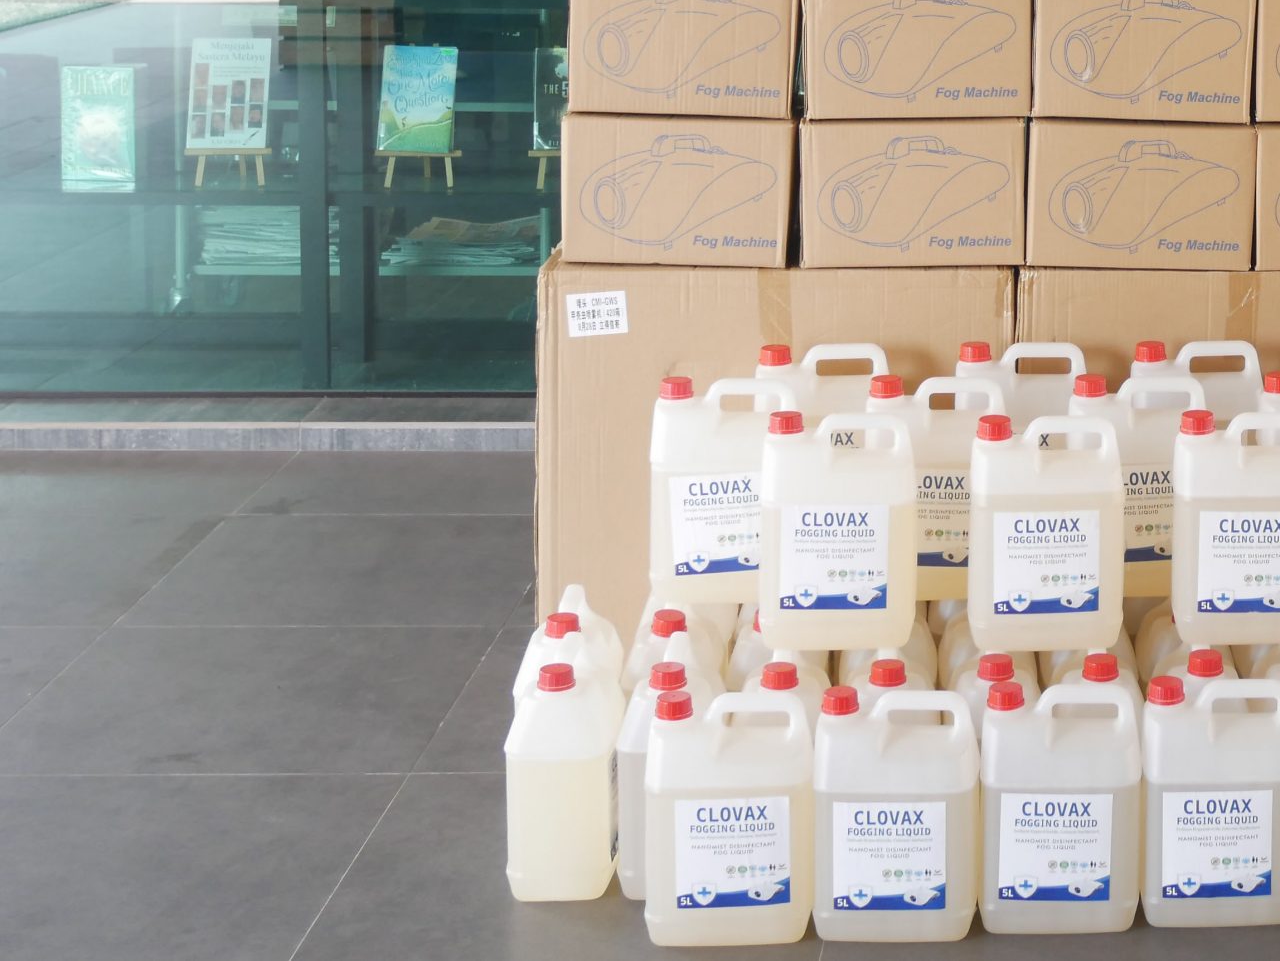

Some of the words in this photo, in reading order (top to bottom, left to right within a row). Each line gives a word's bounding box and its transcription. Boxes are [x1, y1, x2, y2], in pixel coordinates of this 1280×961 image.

[544, 84, 560, 94] THE
[695, 84, 720, 99] Fog
[724, 85, 781, 99] Machine
[935, 87, 962, 101] Fog
[964, 87, 1018, 99] Machine
[1158, 91, 1183, 105] Fog
[1187, 91, 1241, 105] Machine
[693, 235, 718, 250] Fog
[723, 235, 778, 249] Machine
[928, 235, 955, 250] Fog
[958, 235, 1012, 248] Machine
[1158, 239, 1182, 253] Fog
[1186, 239, 1240, 252] Machine
[689, 479, 751, 497] CLOVAX
[684, 497, 724, 507] FOGGING
[727, 495, 759, 505] LIQUID
[802, 512, 868, 527] CLOVAX
[1014, 518, 1080, 534] CLOVAX
[794, 529, 838, 538] FOGGING
[840, 529, 875, 539] LIQUID
[1007, 535, 1050, 545] FOGGING
[1053, 534, 1087, 544] LIQUID
[1212, 535, 1255, 544] FOGGING
[677, 565, 689, 573] 5L
[998, 603, 1008, 612] 5L
[1022, 801, 1092, 817] CLOVAX
[1183, 799, 1252, 815] CLOVAX
[696, 805, 768, 823] CLOVAX
[854, 810, 924, 825] CLOVAX
[1176, 816, 1221, 825] FOGGING
[1224, 815, 1258, 825] LIQUID
[690, 823, 736, 834] FOGGING
[739, 821, 775, 833] LIQUID
[1014, 819, 1060, 828] FOGGING
[1062, 819, 1098, 829] LIQUID
[848, 827, 892, 837] FOGGING
[896, 827, 932, 837] LIQUID
[1166, 887, 1178, 896] 5L
[837, 899, 848, 907] 5L
